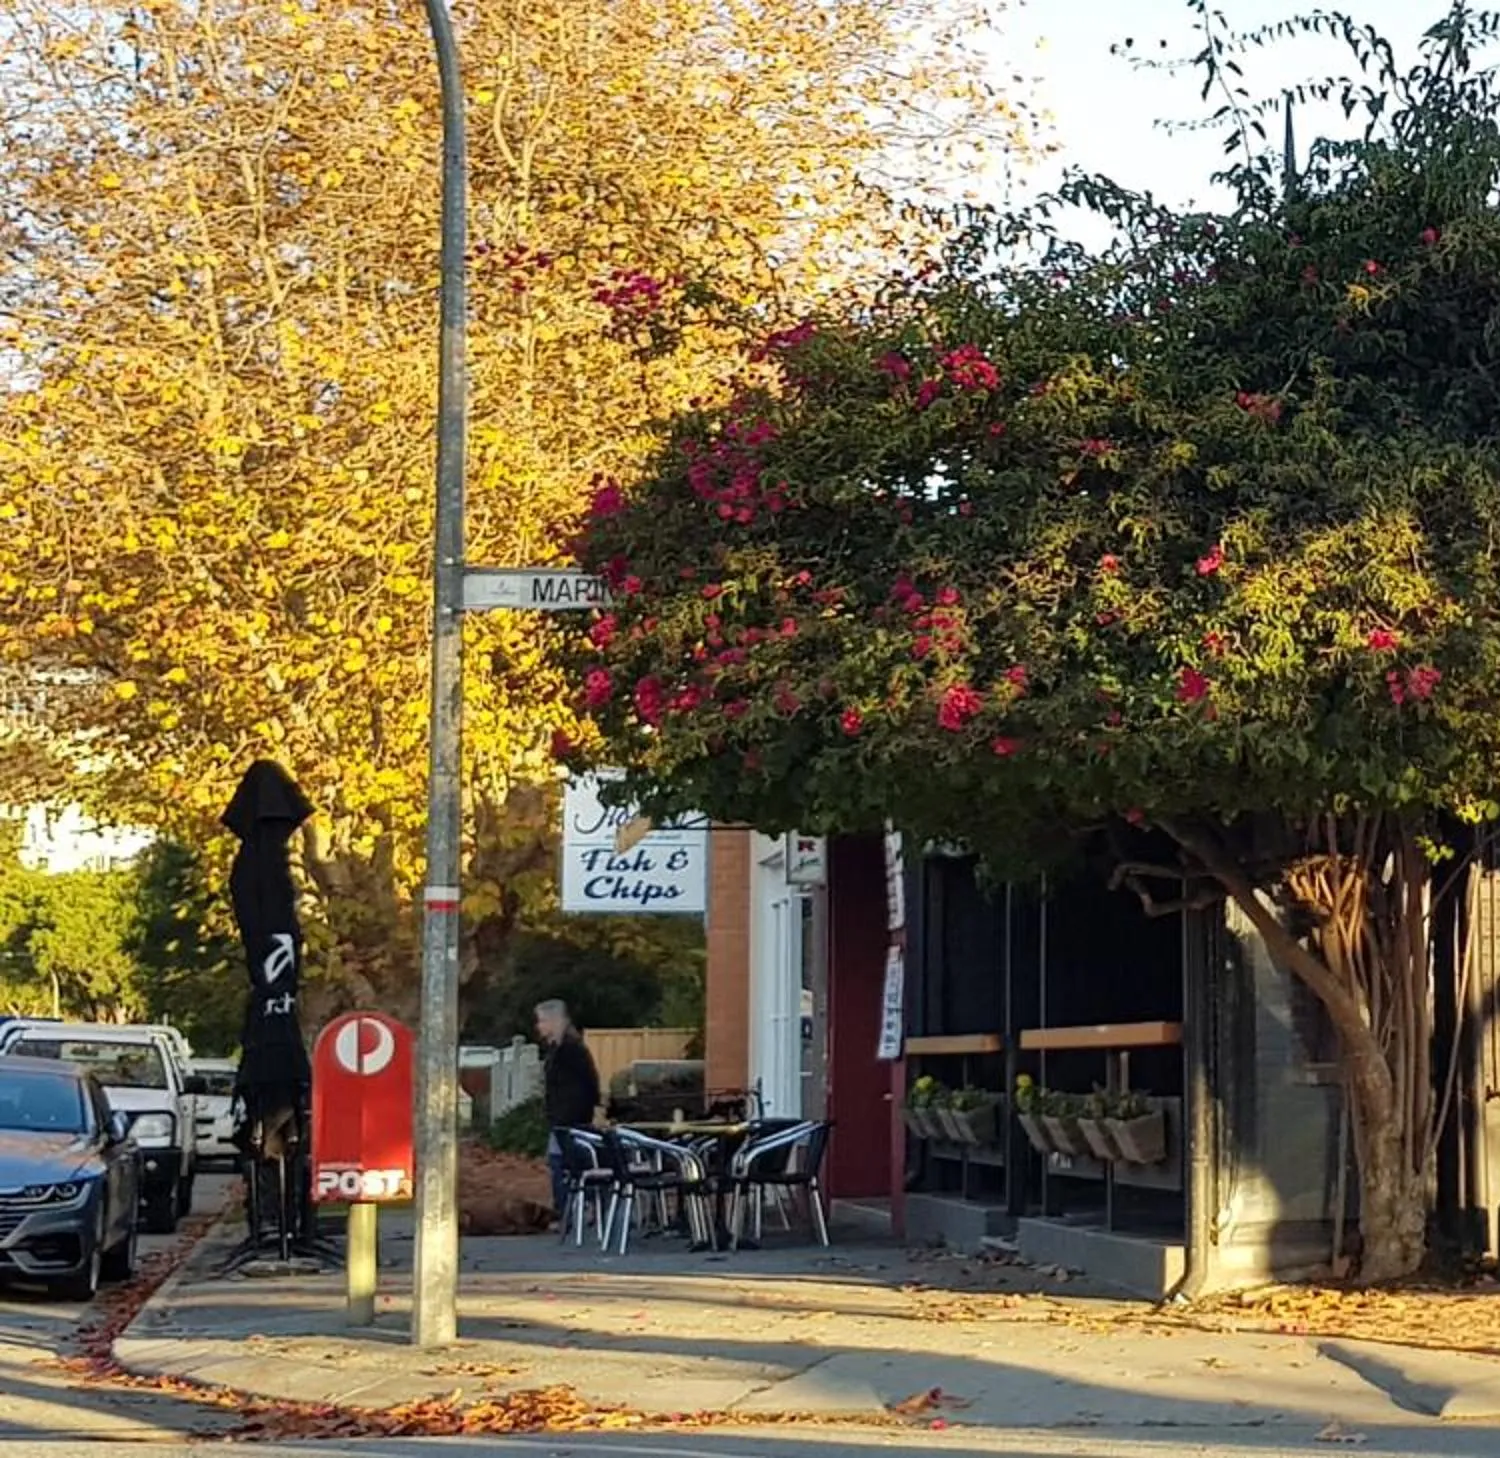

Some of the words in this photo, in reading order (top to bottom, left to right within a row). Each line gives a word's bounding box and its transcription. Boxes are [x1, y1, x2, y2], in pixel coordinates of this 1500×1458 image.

[581, 849, 656, 871] Fish
[666, 849, 688, 871] &
[584, 876, 685, 904] Chips
[318, 1169, 405, 1197] POST
